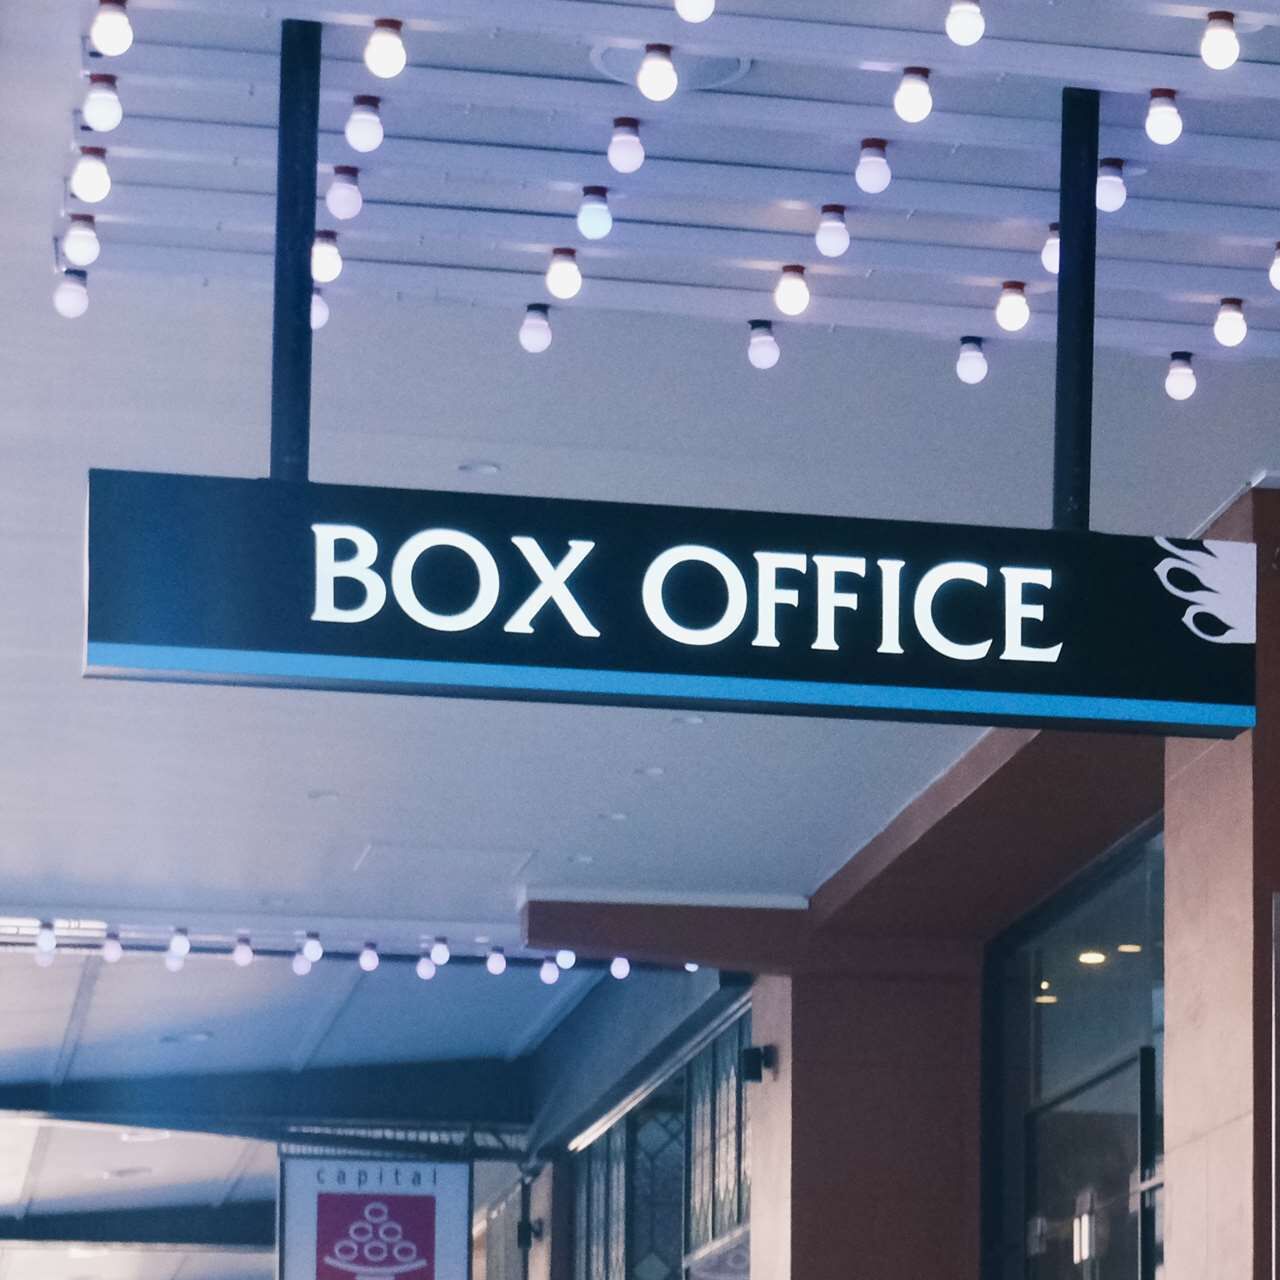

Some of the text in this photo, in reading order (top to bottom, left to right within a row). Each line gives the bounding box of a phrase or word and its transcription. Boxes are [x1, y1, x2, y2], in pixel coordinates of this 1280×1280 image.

[310, 523, 1064, 663] BOX OFFICE
[316, 1166, 437, 1190] capital
